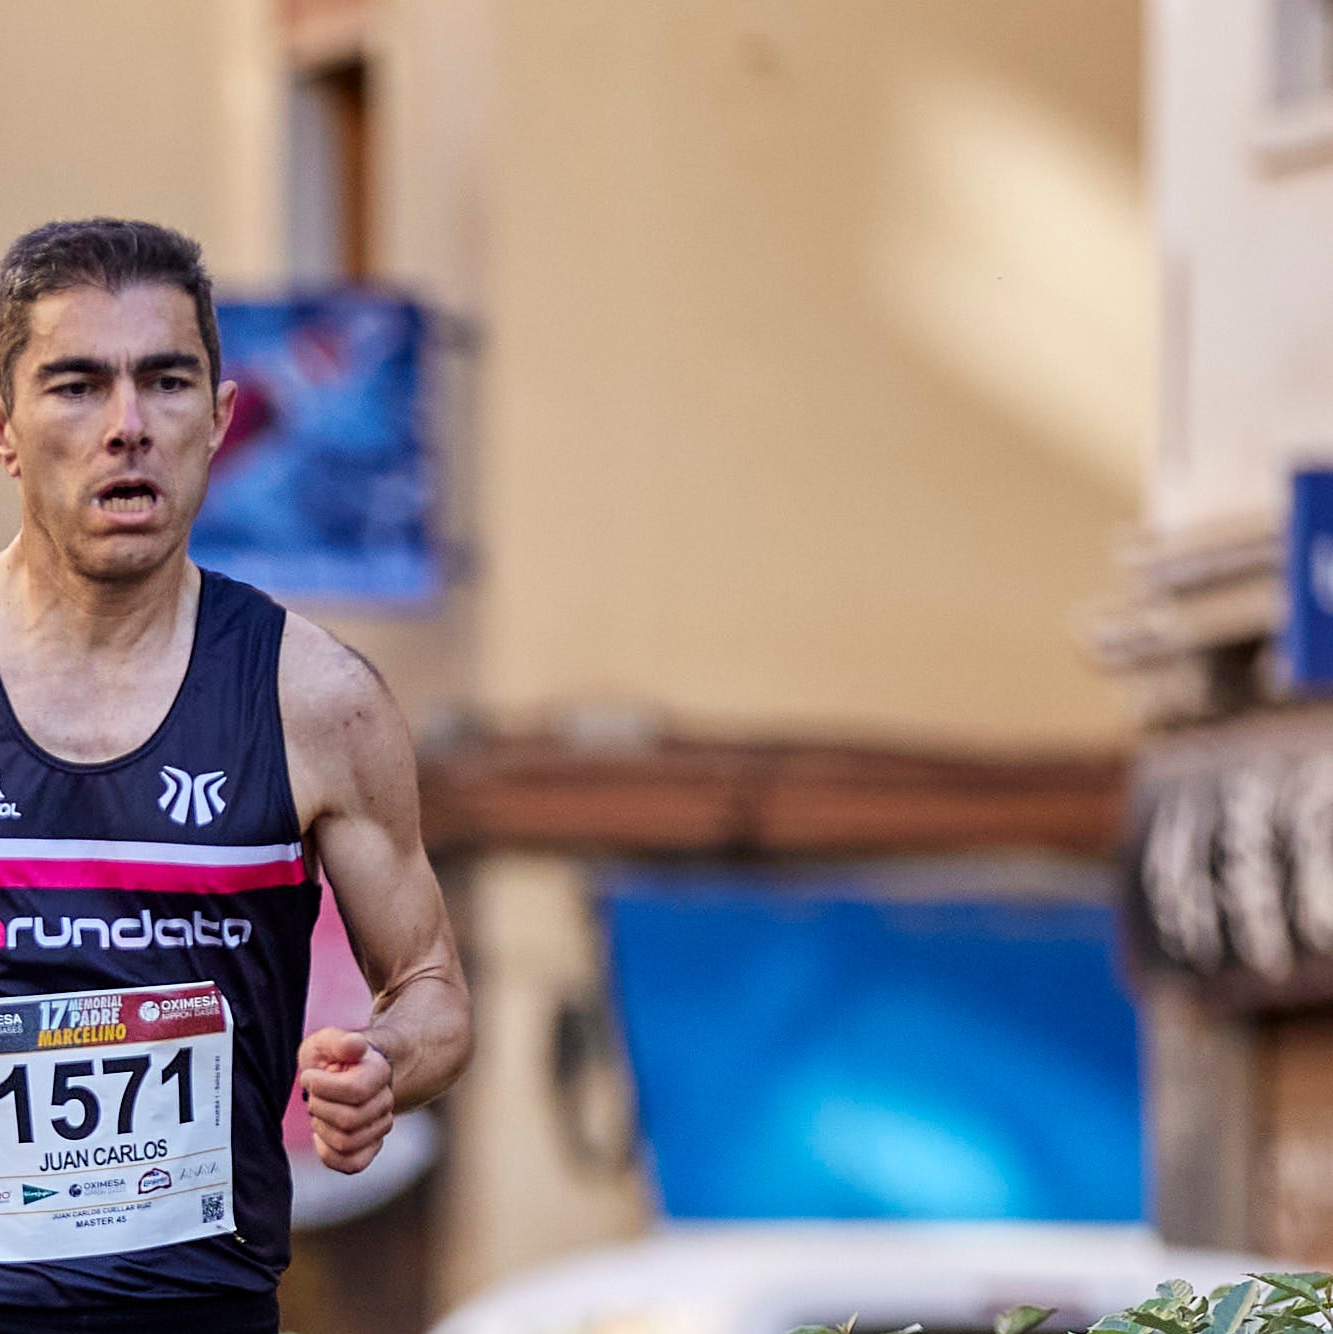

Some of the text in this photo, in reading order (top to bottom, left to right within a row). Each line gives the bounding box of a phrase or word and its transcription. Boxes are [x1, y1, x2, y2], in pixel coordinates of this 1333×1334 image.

[39, 995, 123, 1031] 17 MEMORIAL
[161, 996, 219, 1011] OXIMESA
[70, 1007, 121, 1028] PADRE
[37, 1022, 127, 1048] MARCELINO
[39, 1139, 168, 1172] JUAN CARLOS
[83, 1178, 126, 1190] OXIMESA
[76, 1215, 128, 1229] MASTER 45
